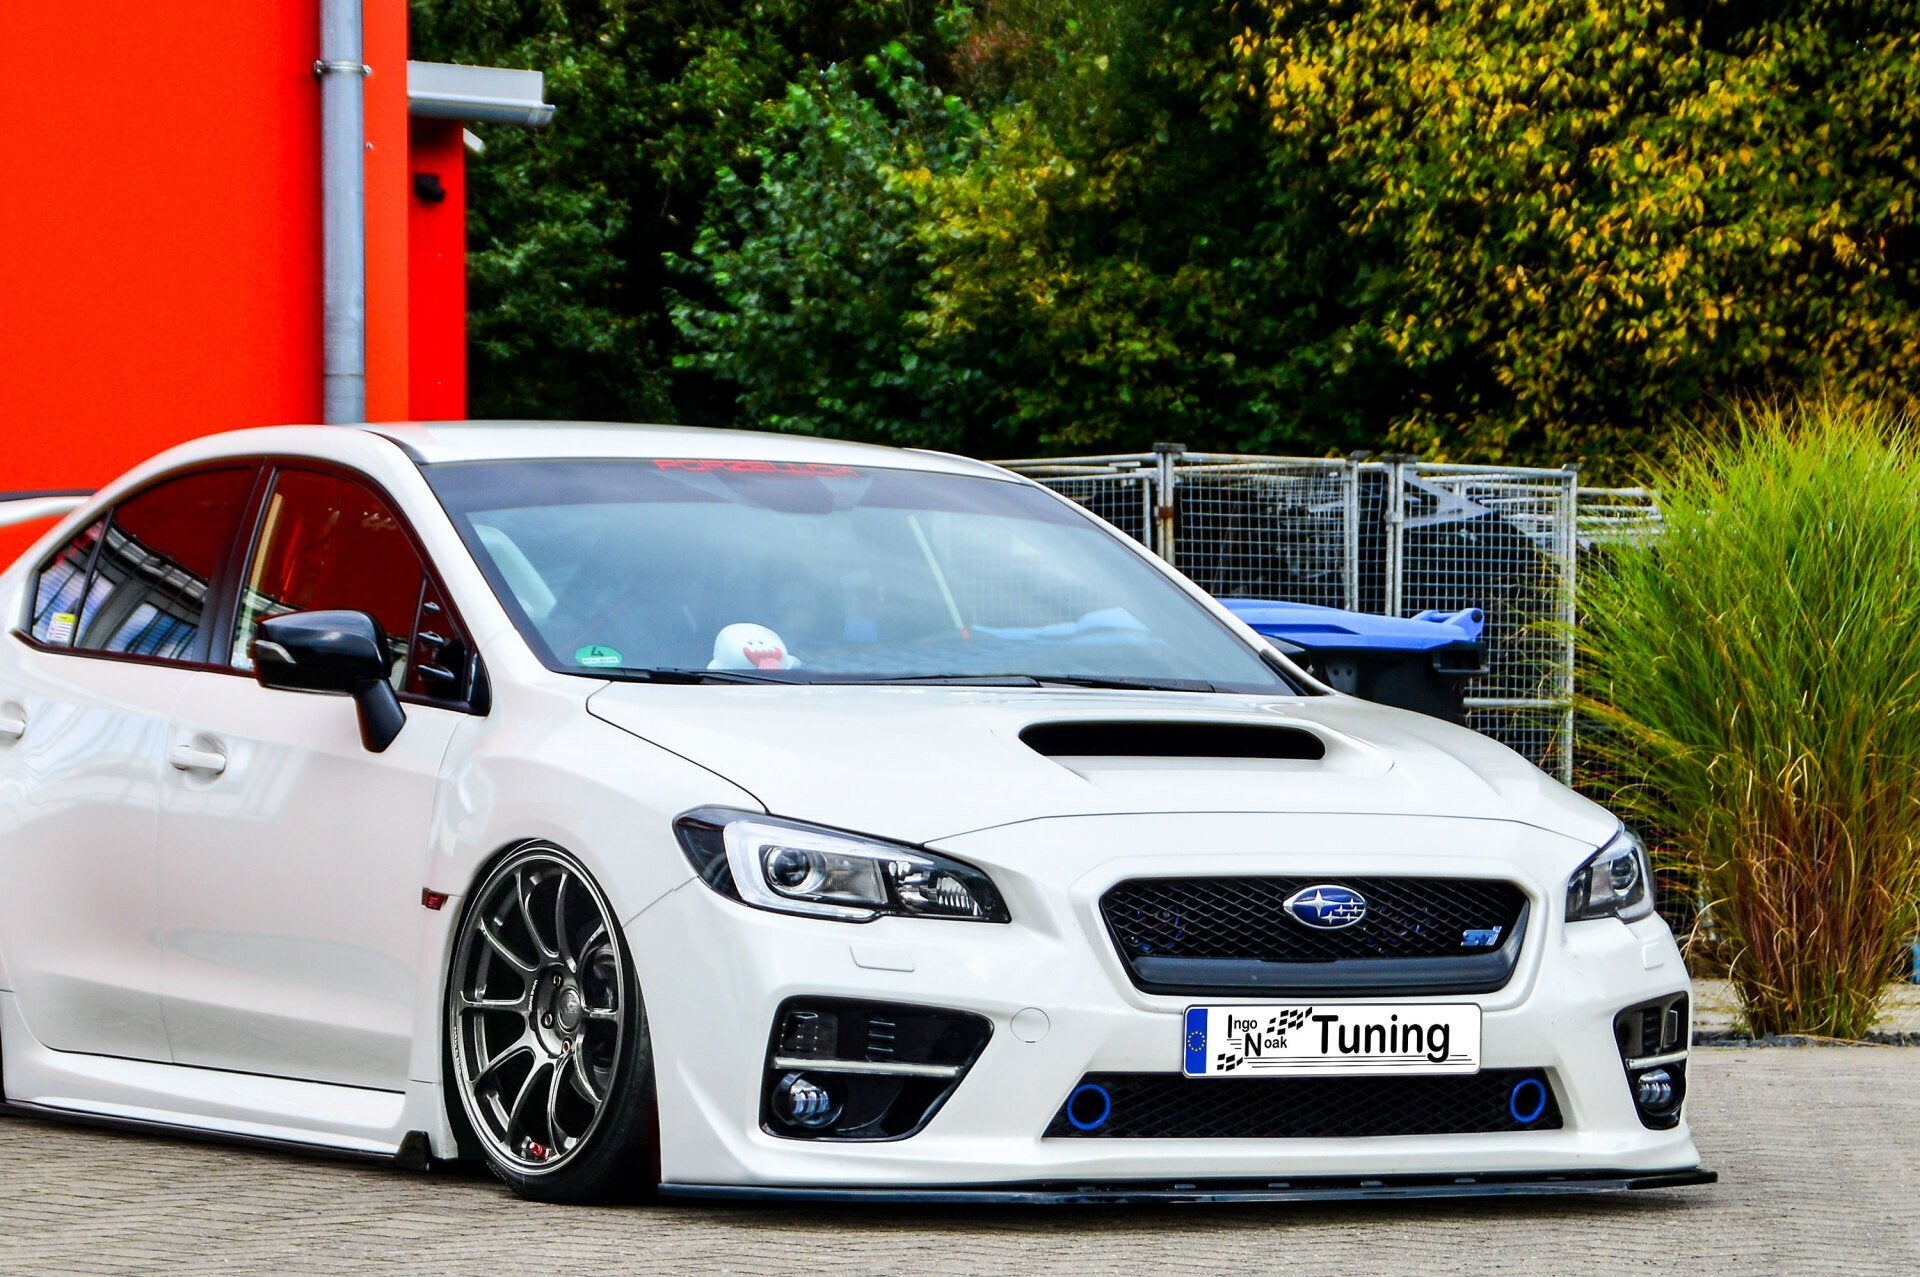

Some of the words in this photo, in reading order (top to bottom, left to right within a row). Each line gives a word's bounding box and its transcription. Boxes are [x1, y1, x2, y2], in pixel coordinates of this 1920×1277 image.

[591, 646, 604, 657] 4
[1227, 1014, 1258, 1039] Ingo
[1312, 1014, 1450, 1063] Tuning
[1244, 1032, 1288, 1057] Noak
